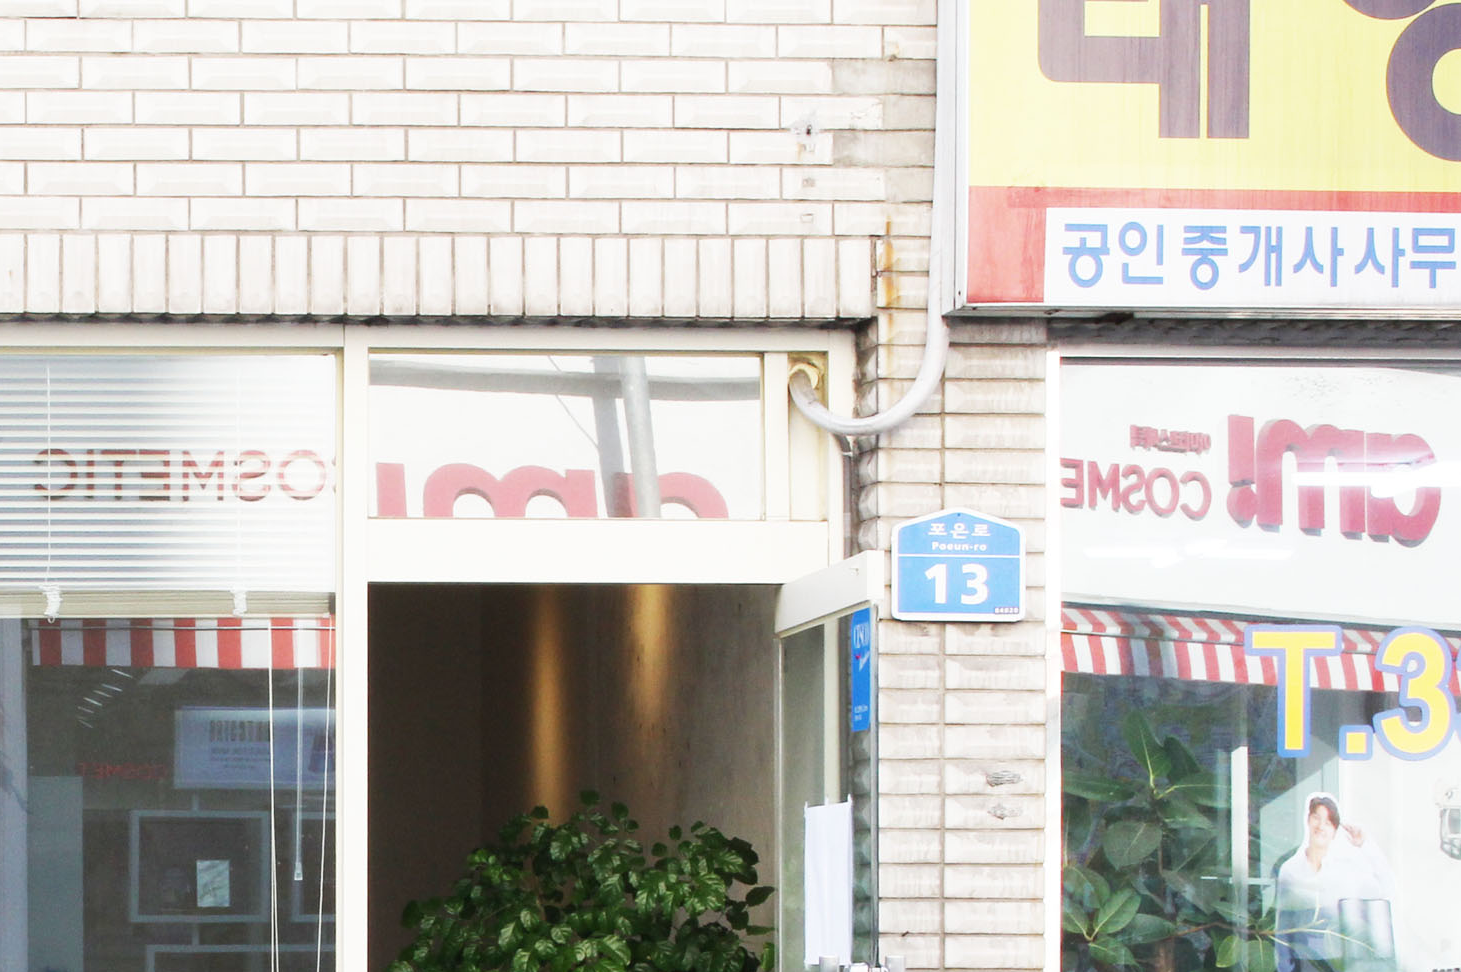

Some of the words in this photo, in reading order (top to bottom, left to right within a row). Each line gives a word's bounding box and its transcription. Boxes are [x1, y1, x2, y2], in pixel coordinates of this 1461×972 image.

[927, 522, 992, 539] 포은로
[924, 563, 990, 605] 13
[1246, 625, 1457, 759] T.3
